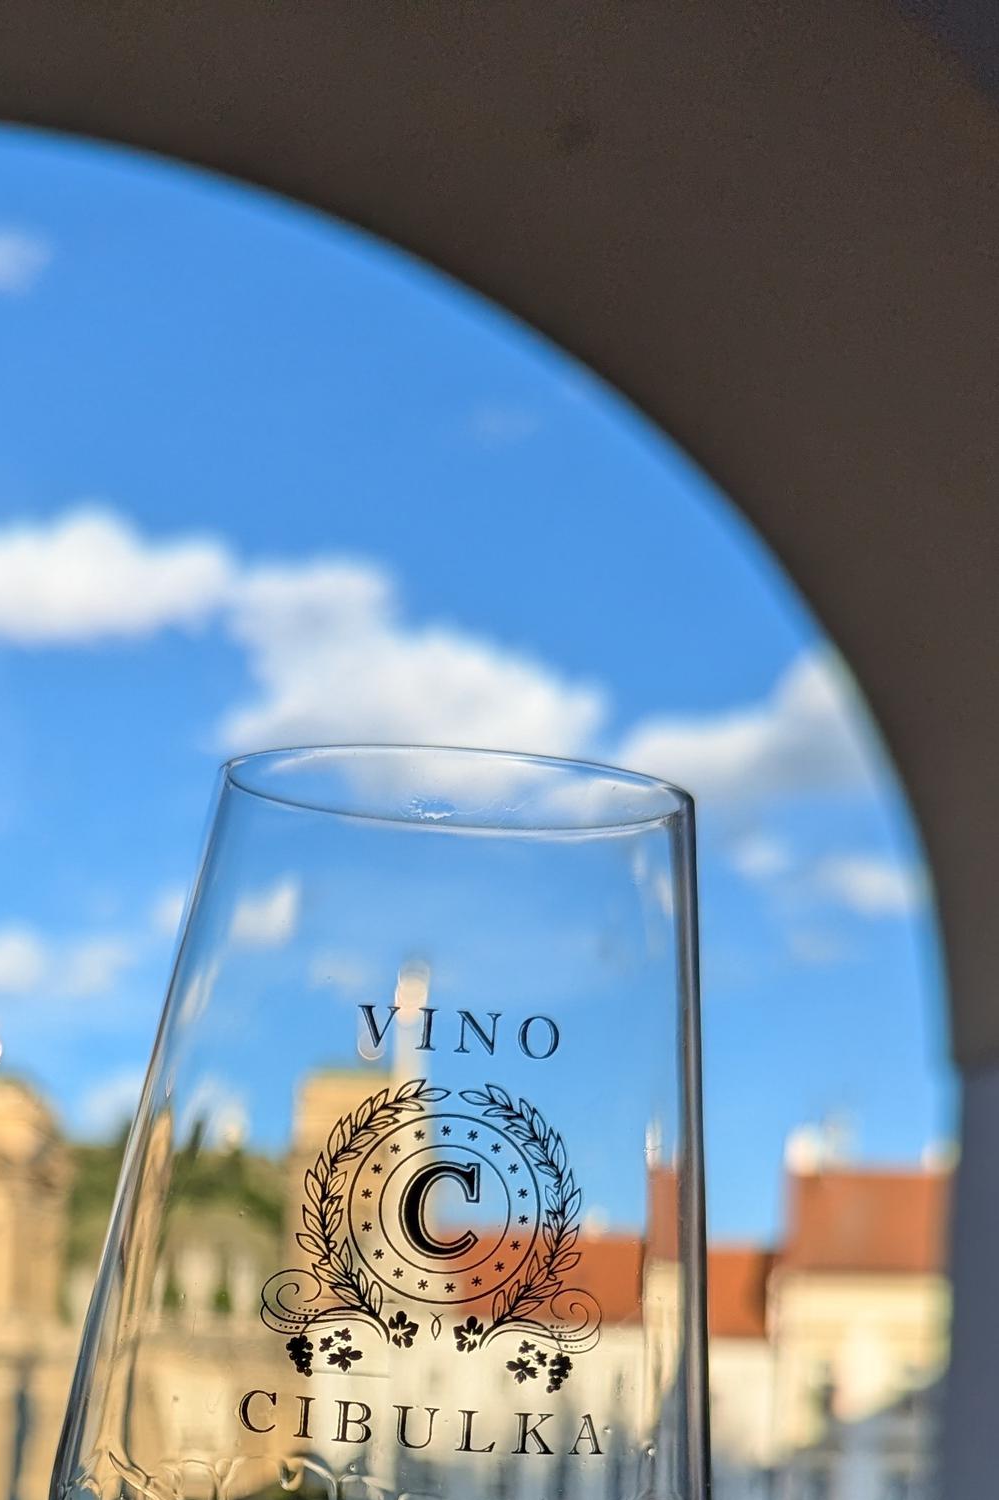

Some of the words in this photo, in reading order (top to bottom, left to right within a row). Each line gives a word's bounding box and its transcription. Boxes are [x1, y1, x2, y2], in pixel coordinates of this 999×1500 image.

[359, 1004, 560, 1060] VINO
[399, 1161, 480, 1260] C
[239, 1389, 603, 1456] CIBULKA
